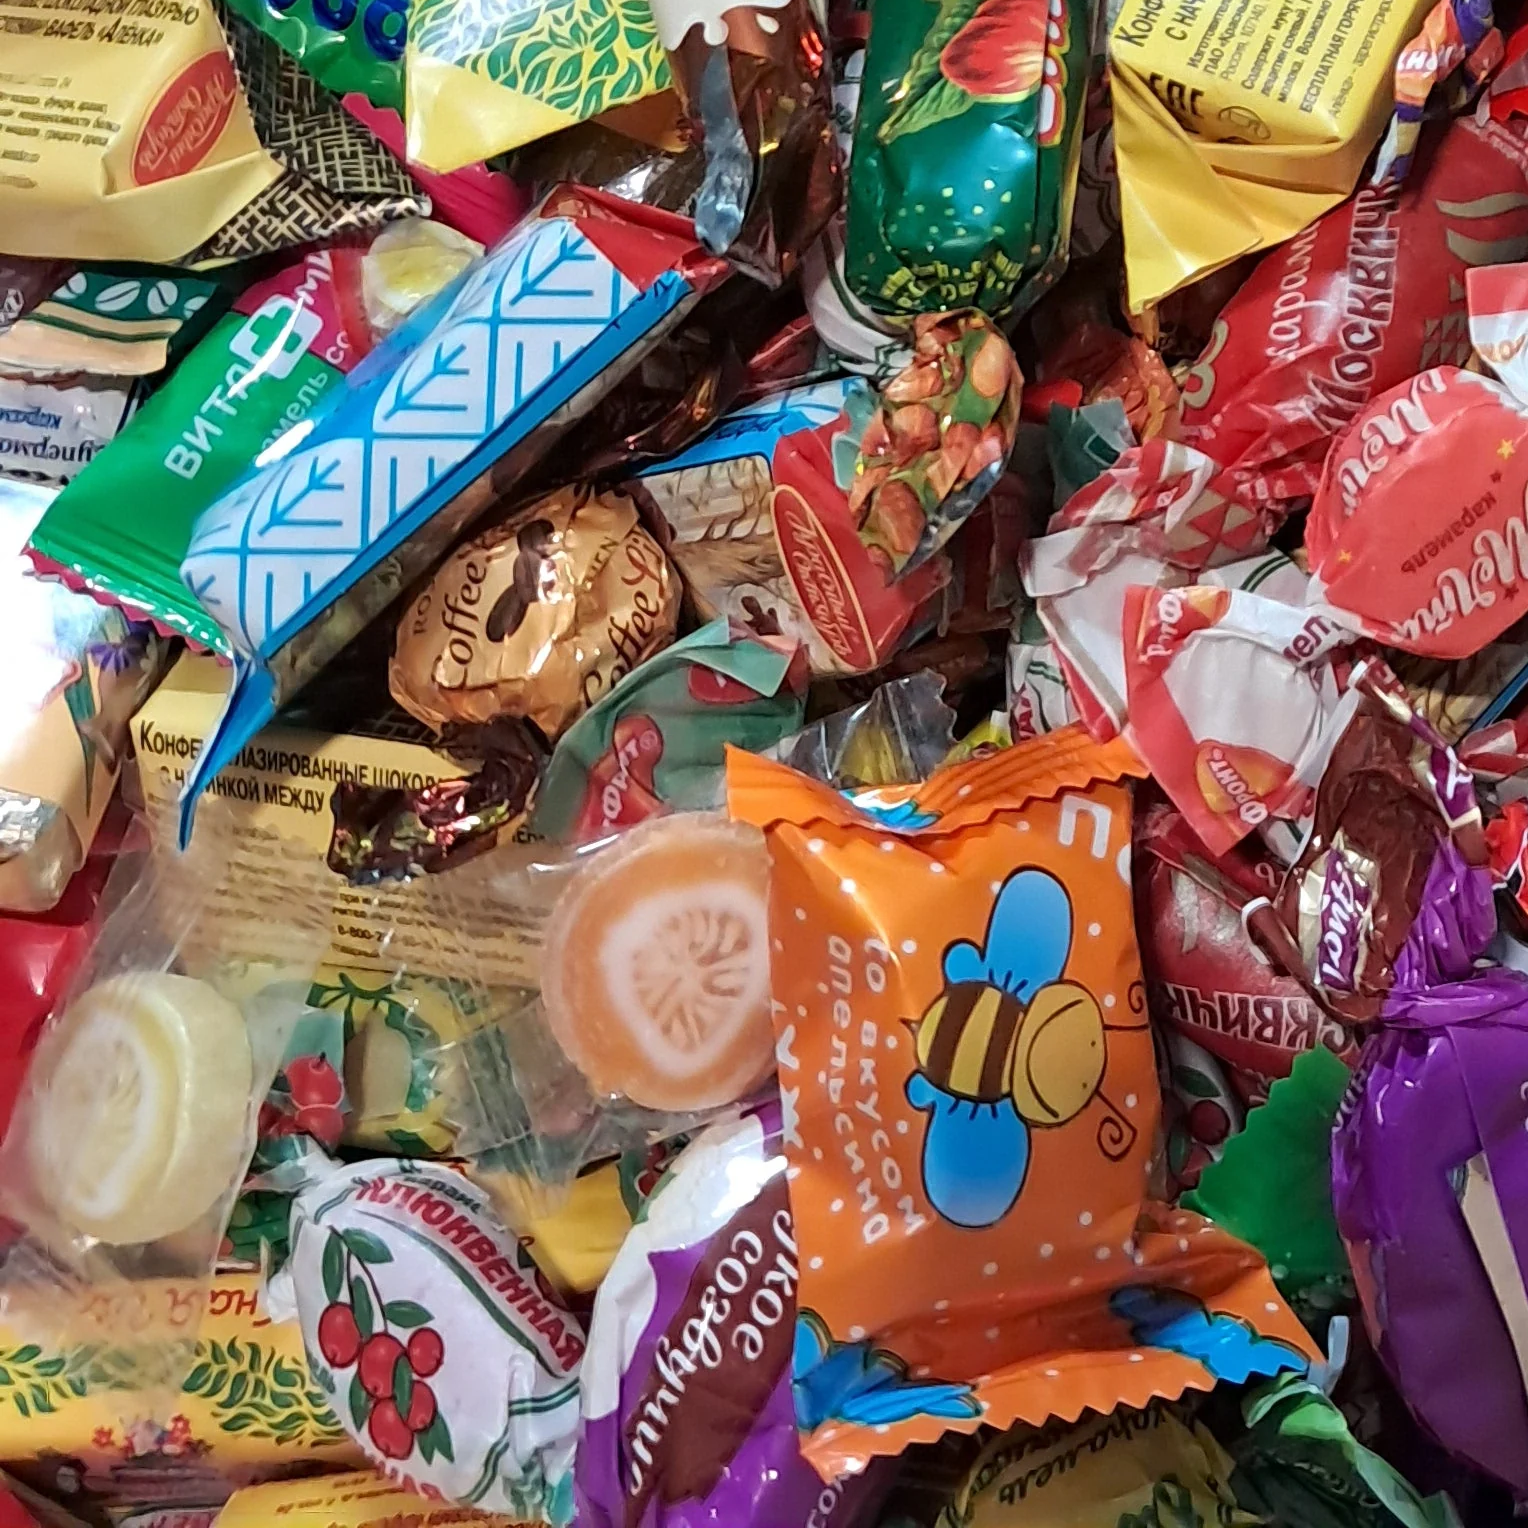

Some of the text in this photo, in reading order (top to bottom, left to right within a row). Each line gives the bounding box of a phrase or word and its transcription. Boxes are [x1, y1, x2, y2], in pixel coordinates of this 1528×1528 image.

[1165, 24, 1188, 44] С
[1268, 217, 1322, 360] карам
[1403, 497, 1498, 575] карамель
[137, 718, 370, 792] КОНФЕ ЛАЗИРОВАННЫЕ
[262, 782, 327, 816] МЕЖДУ
